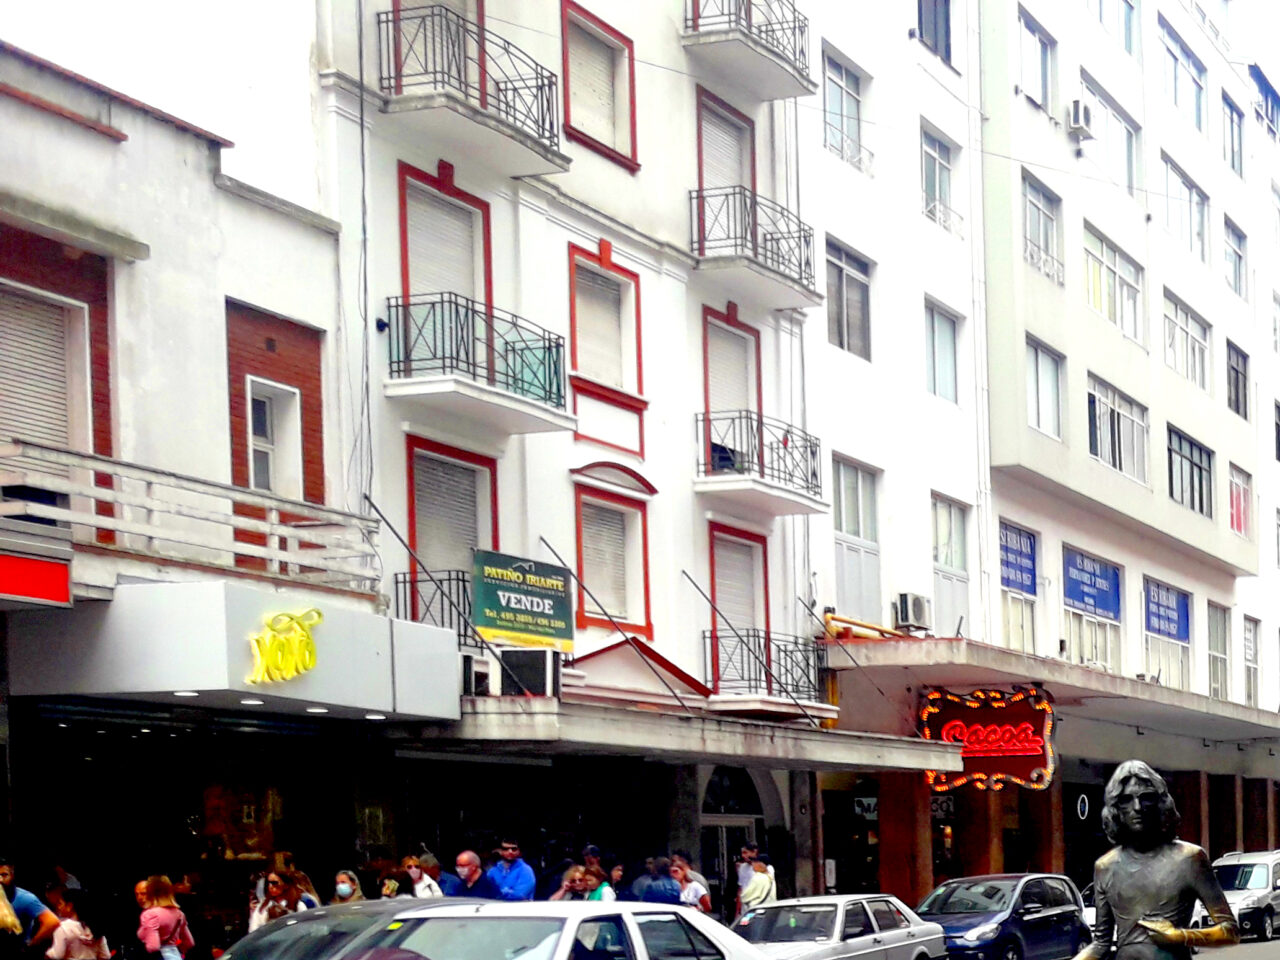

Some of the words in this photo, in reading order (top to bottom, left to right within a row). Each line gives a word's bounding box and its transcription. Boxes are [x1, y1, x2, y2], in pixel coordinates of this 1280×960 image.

[483, 566, 523, 583] PATIÑO
[526, 574, 565, 591] IRIARTE
[497, 590, 554, 615] VENDE
